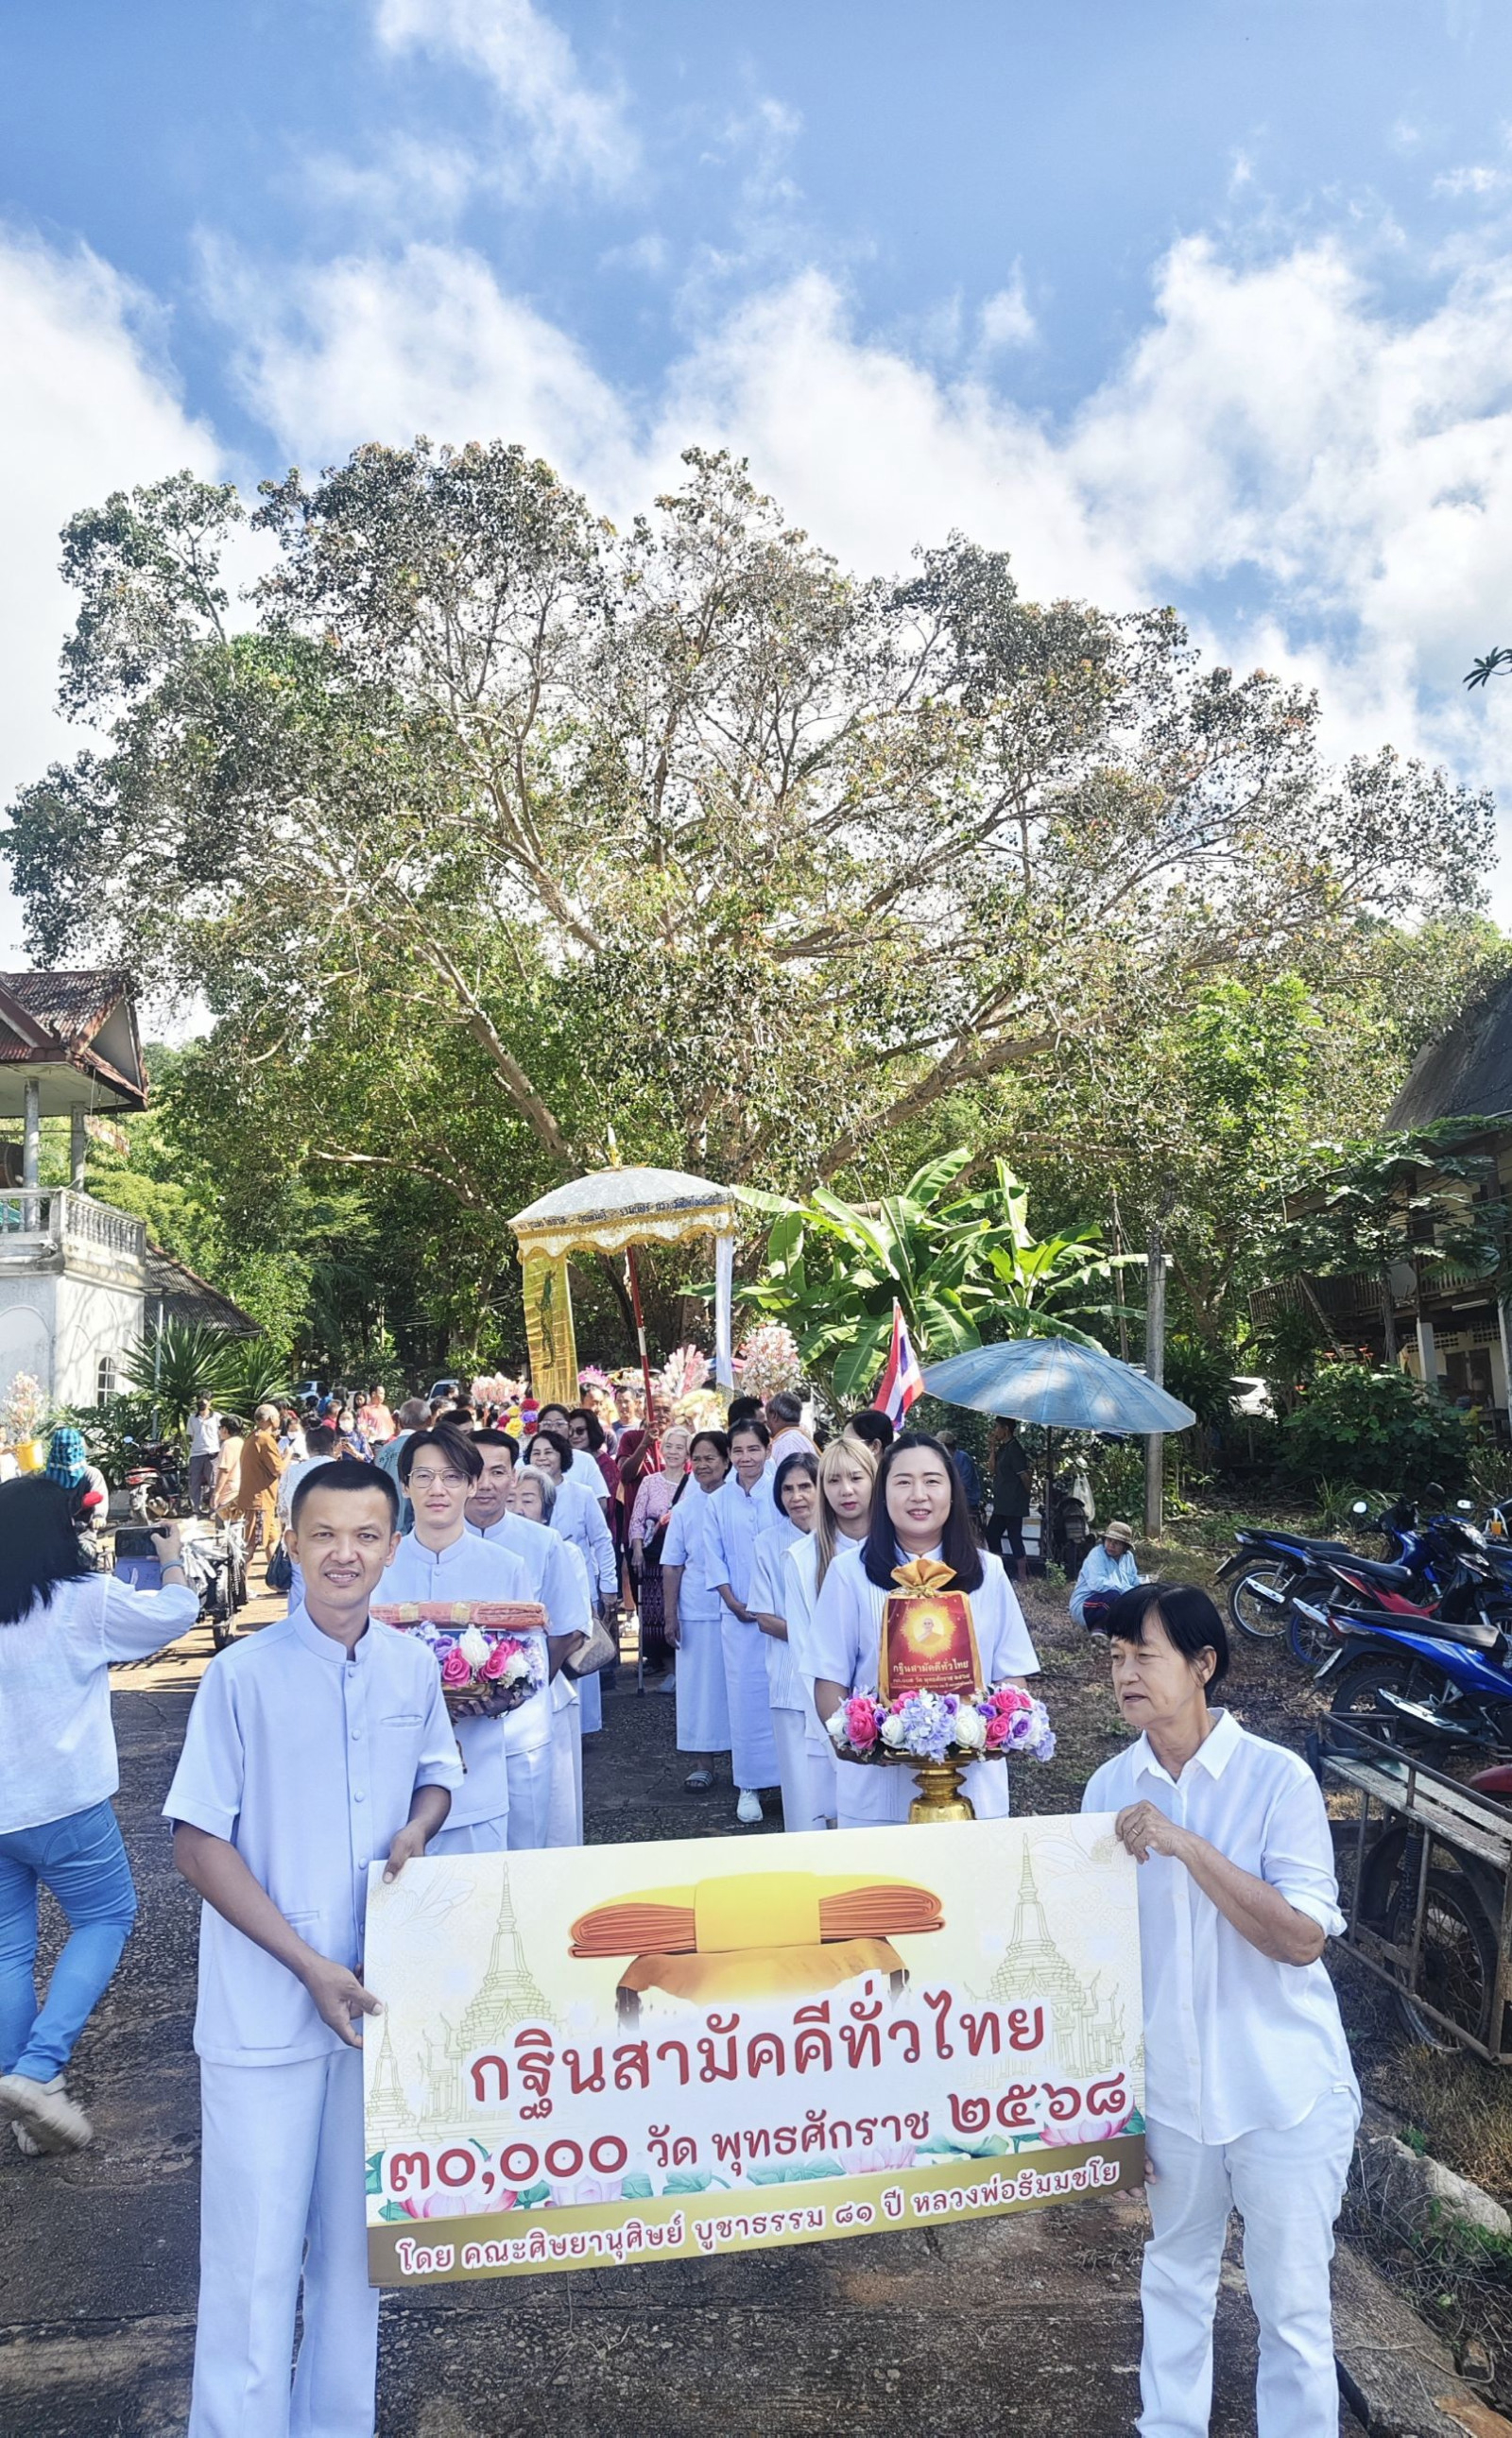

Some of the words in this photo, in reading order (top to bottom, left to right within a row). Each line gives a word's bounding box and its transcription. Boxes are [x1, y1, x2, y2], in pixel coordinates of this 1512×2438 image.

[472, 1979, 1044, 2120] กฐินสามัคคีทั่วไทย
[389, 2135, 628, 2195] ๓๐,๐๐๐
[646, 2124, 697, 2168] วัด
[712, 2108, 930, 2177] พุทธศักราช
[947, 2072, 1126, 2134] ๒๕๖๘
[401, 2242, 452, 2271] โดย
[465, 2214, 682, 2261] คณะศิษยานุศิษย์
[695, 2206, 824, 2250] บูชาธรรม
[835, 2205, 874, 2224] ๘๑
[885, 2192, 902, 2217] ปี
[914, 2159, 1119, 2214] หลวงพ่อธัมมชโย
